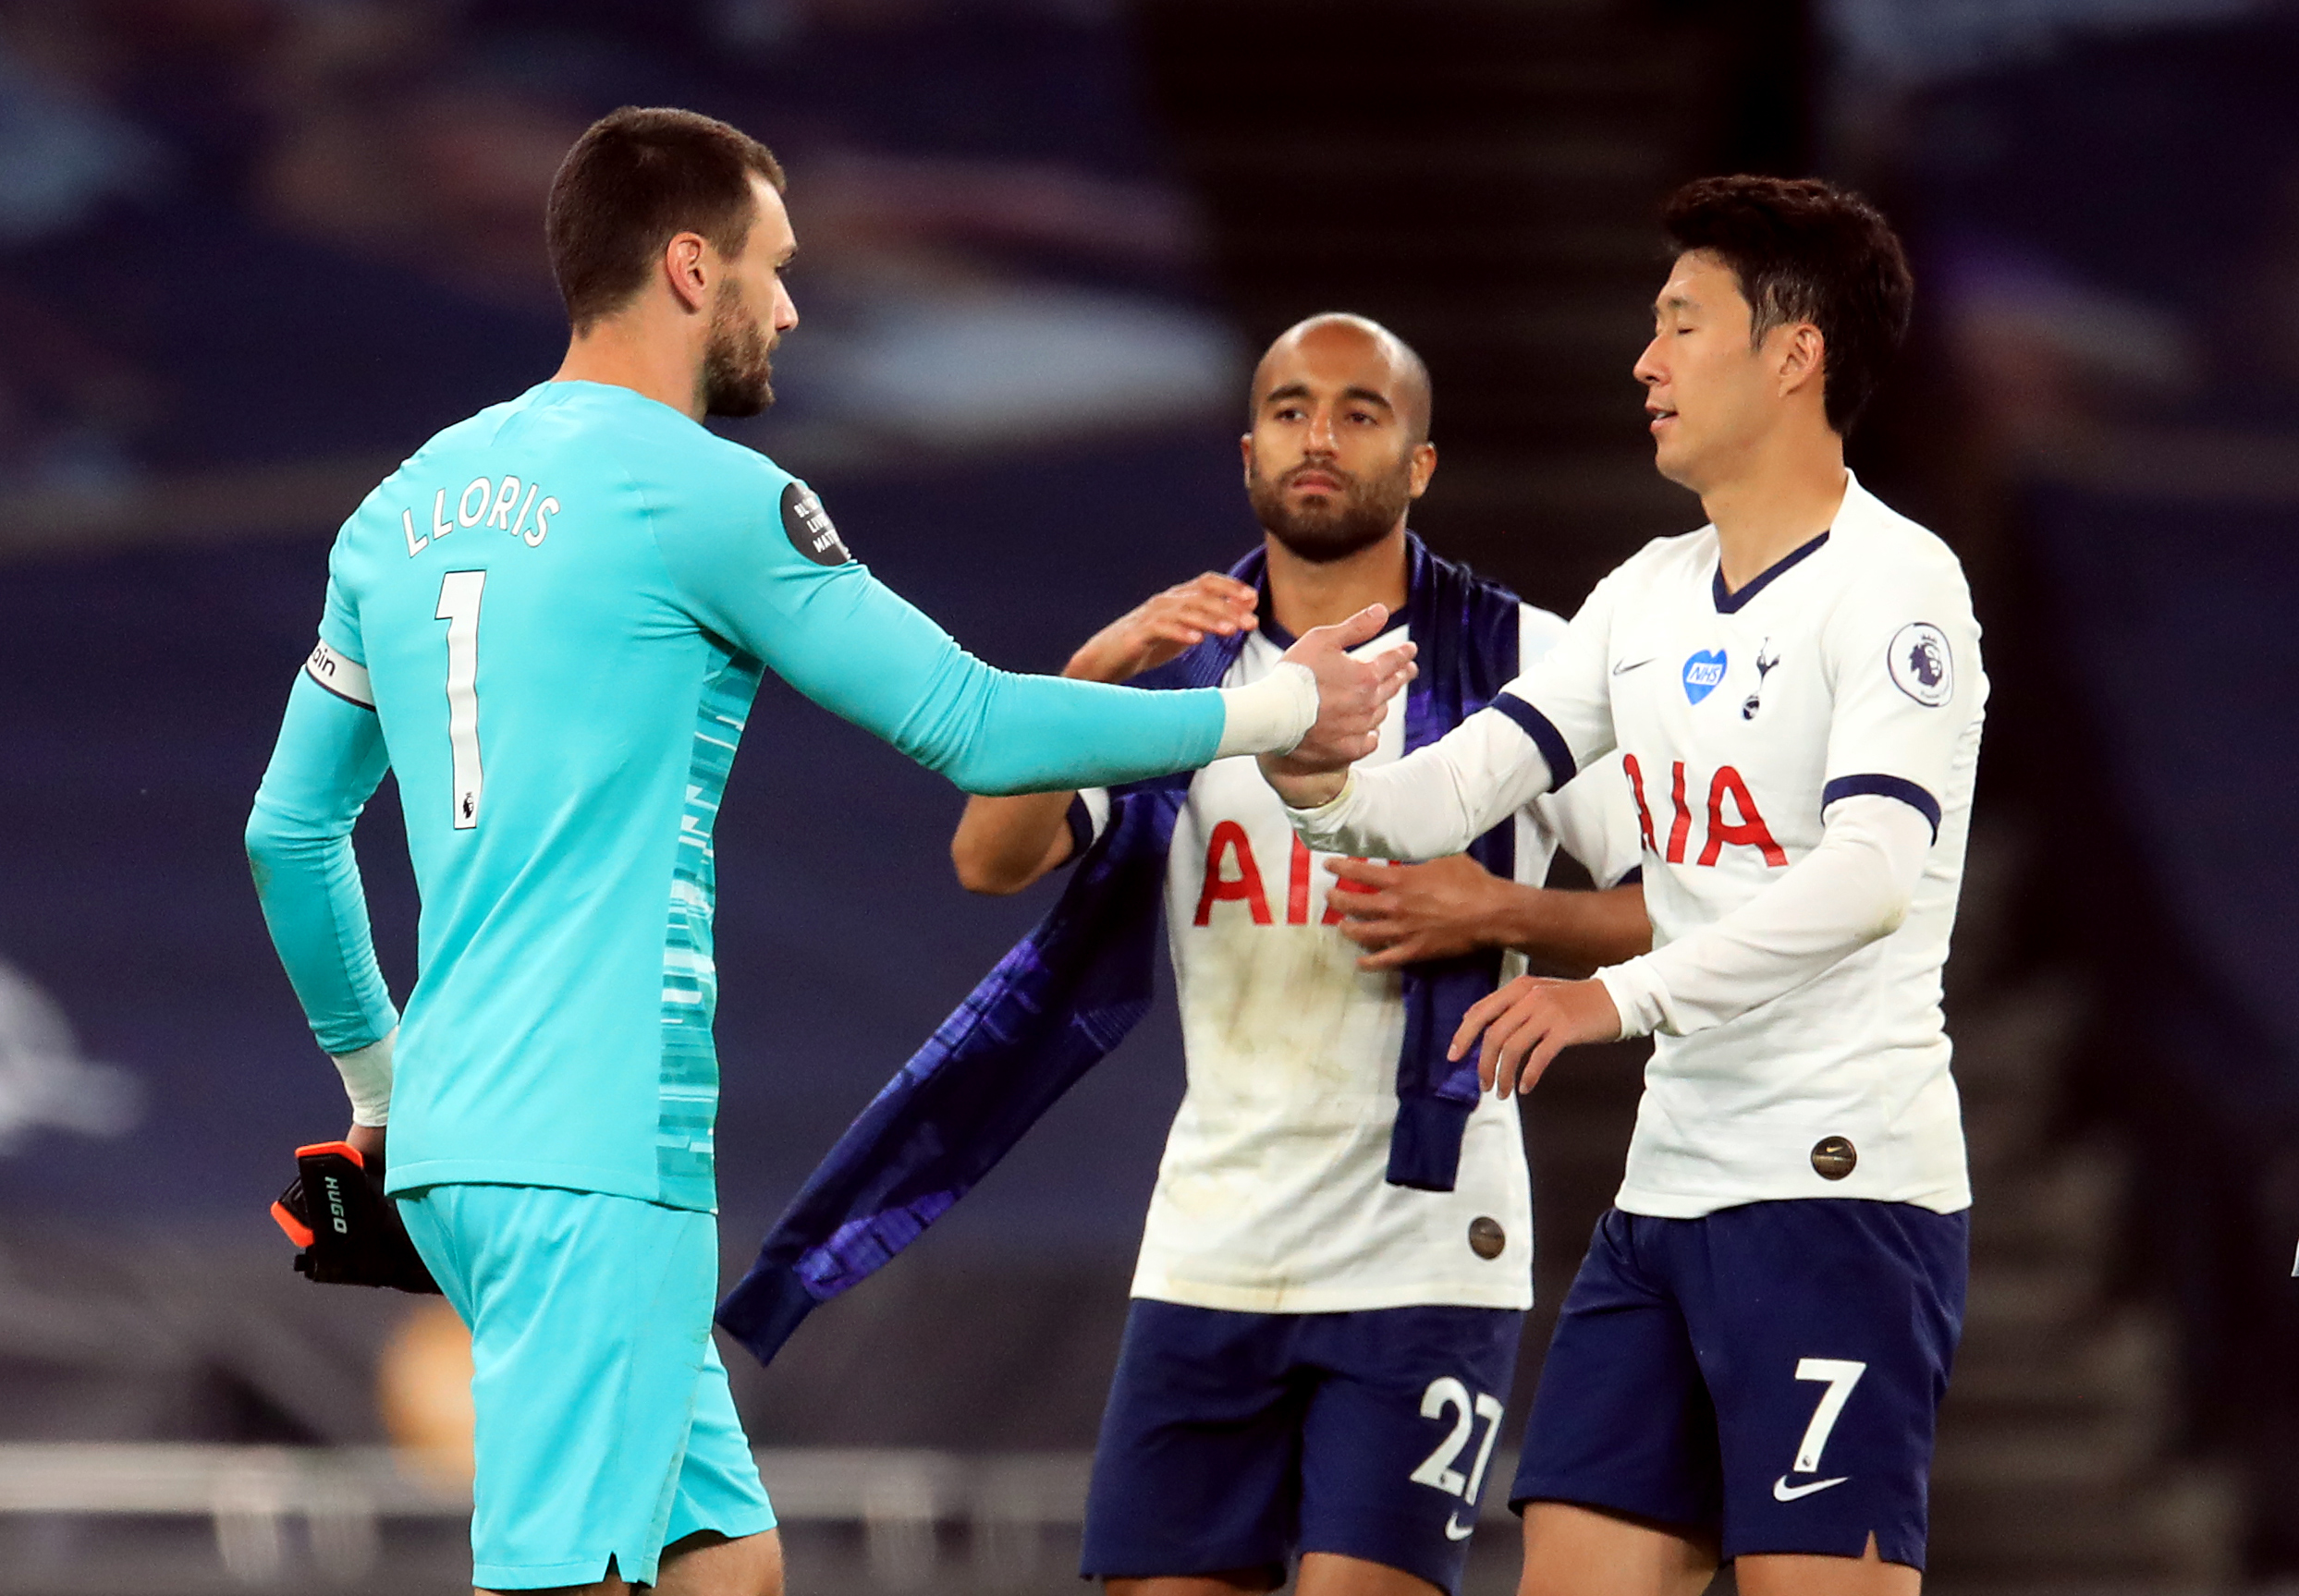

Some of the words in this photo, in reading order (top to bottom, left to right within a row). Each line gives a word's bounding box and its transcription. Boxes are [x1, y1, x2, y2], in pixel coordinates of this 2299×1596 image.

[402, 475, 560, 557] LLORIS
[434, 569, 487, 829] 1
[1690, 665, 1721, 682] NHS
[324, 1176, 348, 1235] HUGO
[1410, 1376, 1504, 1506] 27
[1793, 1358, 1867, 1473] 7
